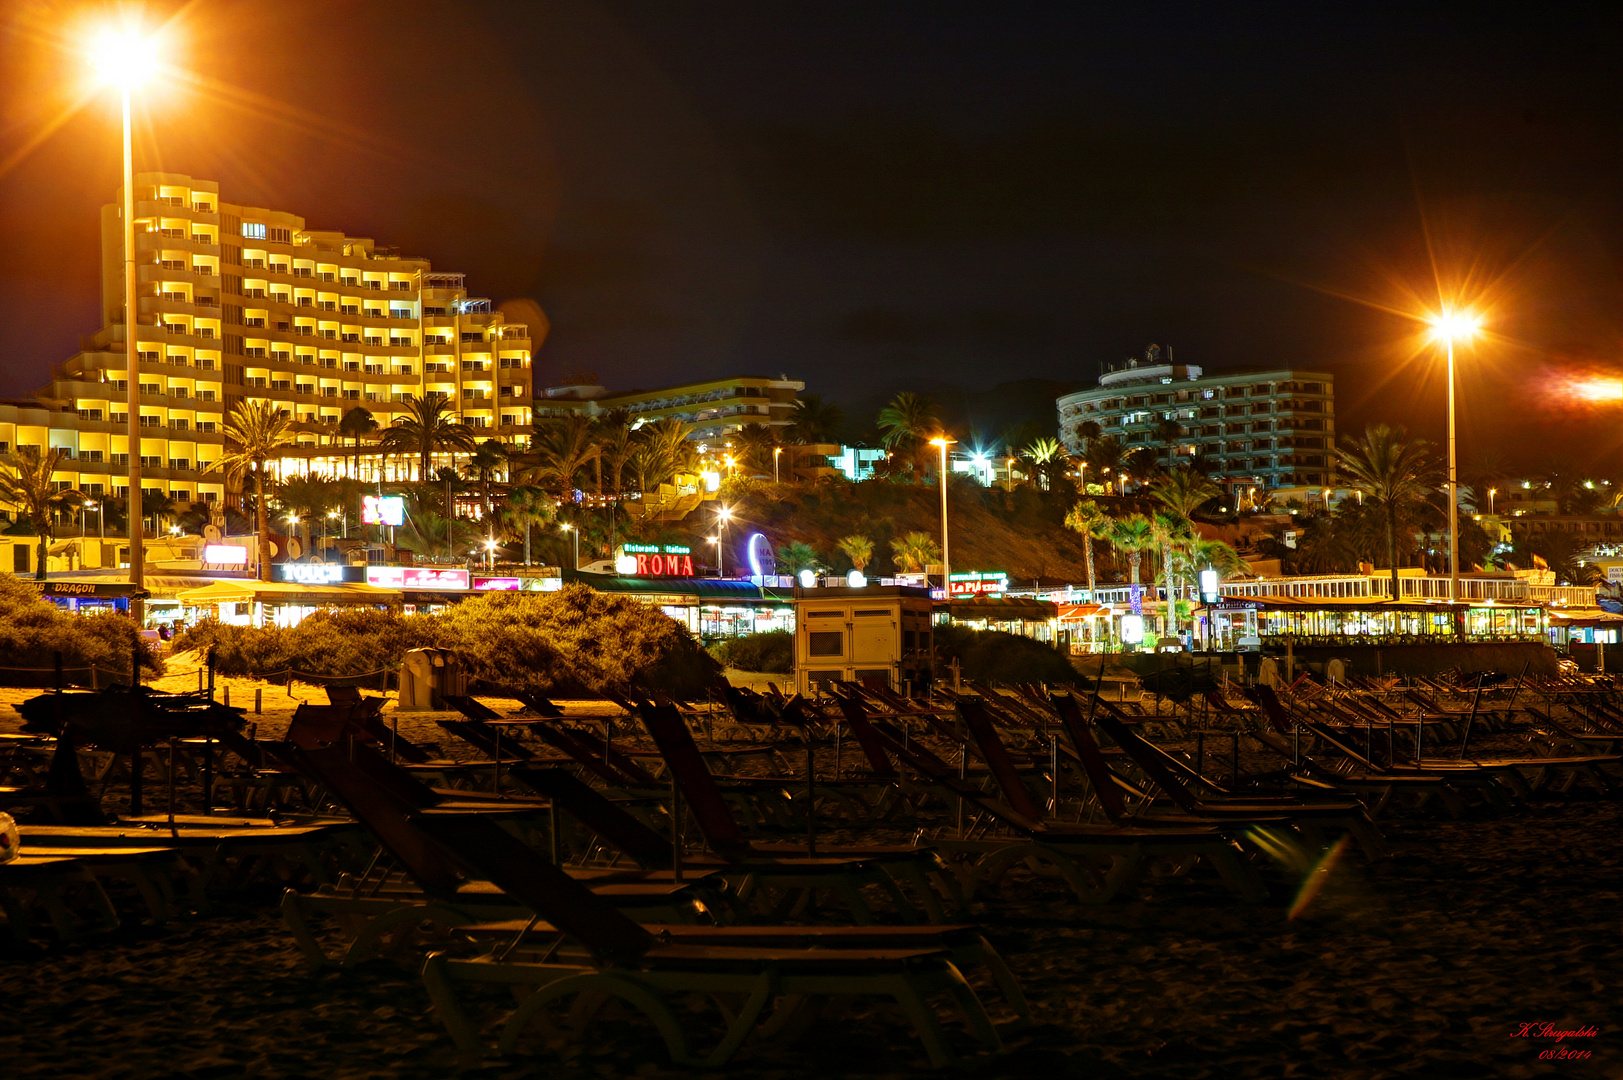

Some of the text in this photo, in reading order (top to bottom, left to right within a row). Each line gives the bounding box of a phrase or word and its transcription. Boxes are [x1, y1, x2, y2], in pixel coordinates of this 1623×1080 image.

[623, 543, 691, 554] Ristorante Italiano
[636, 553, 695, 576] ROMA
[951, 583, 964, 593] La
